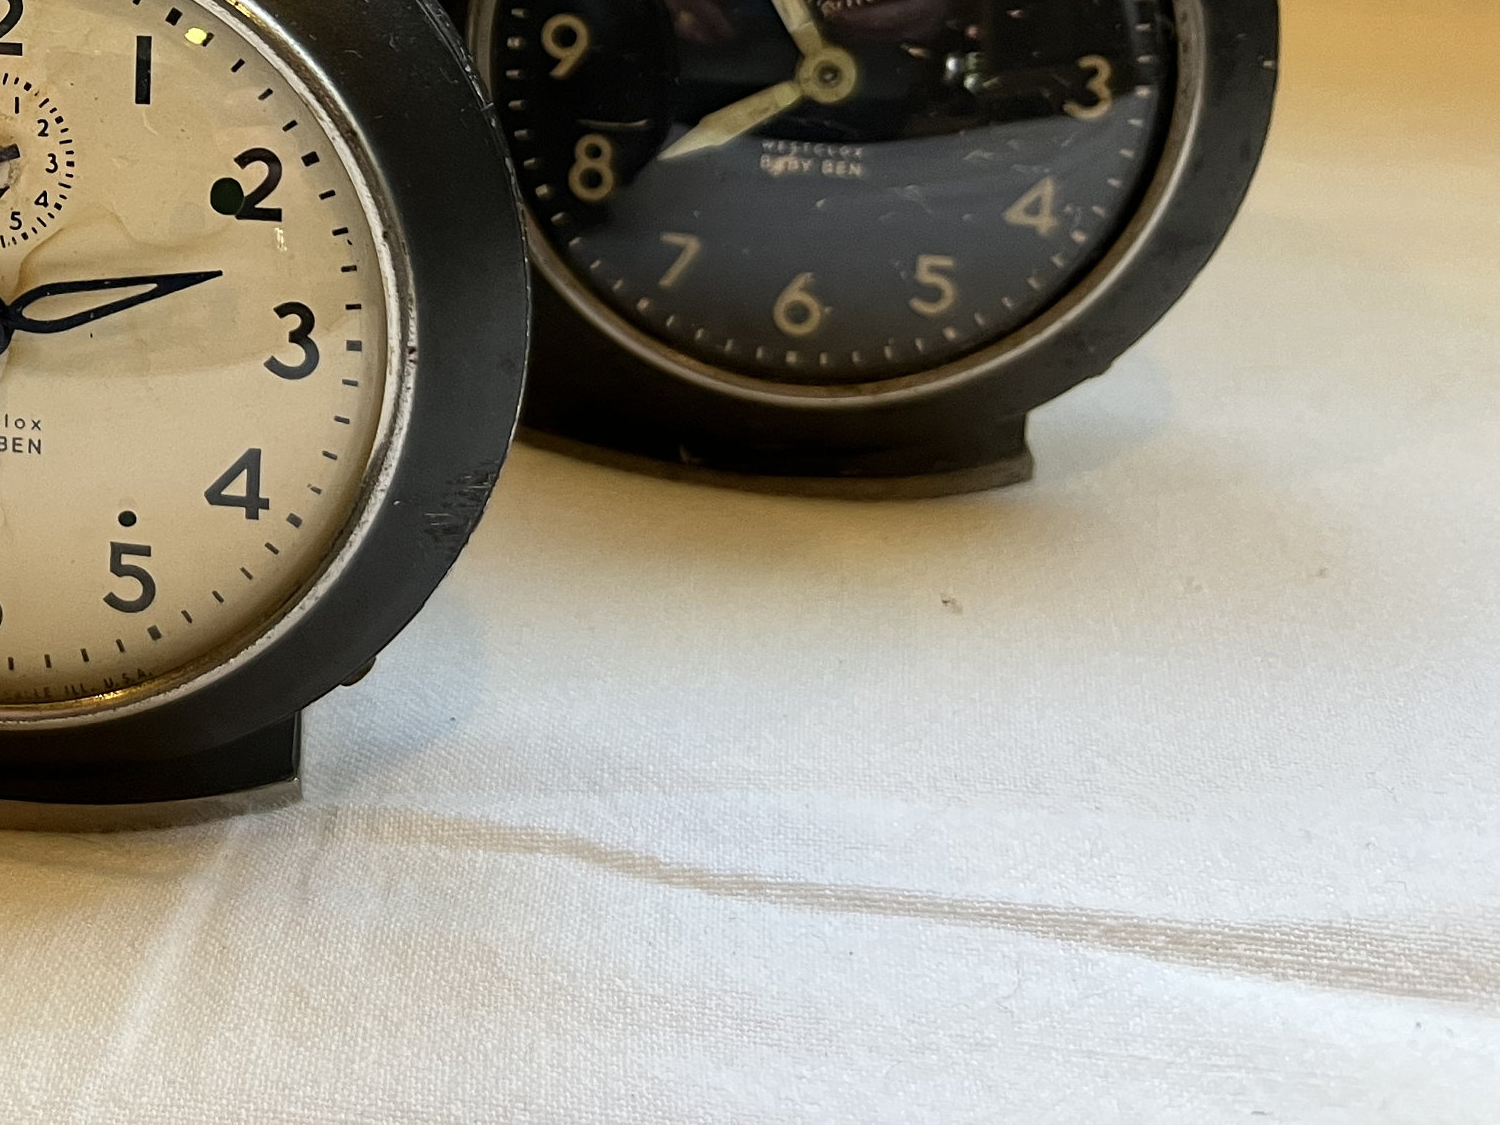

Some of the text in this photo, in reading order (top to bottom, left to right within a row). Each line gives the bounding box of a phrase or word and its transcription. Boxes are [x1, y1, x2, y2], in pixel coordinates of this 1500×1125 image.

[134, 34, 153, 106] 1
[541, 13, 588, 79] 9
[14, 96, 20, 114] 1
[1062, 55, 1112, 120] 3
[36, 119, 49, 137] 2
[45, 153, 59, 173] 3
[233, 148, 284, 223] 2
[568, 134, 615, 201] 8
[9, 211, 23, 231] 5
[34, 190, 49, 208] 4
[1004, 177, 1058, 235] 4
[658, 233, 700, 288] 7
[910, 255, 956, 315] 5
[773, 271, 822, 335] 6
[263, 301, 322, 381] 3
[204, 447, 271, 521] 4
[102, 543, 158, 614] 5
